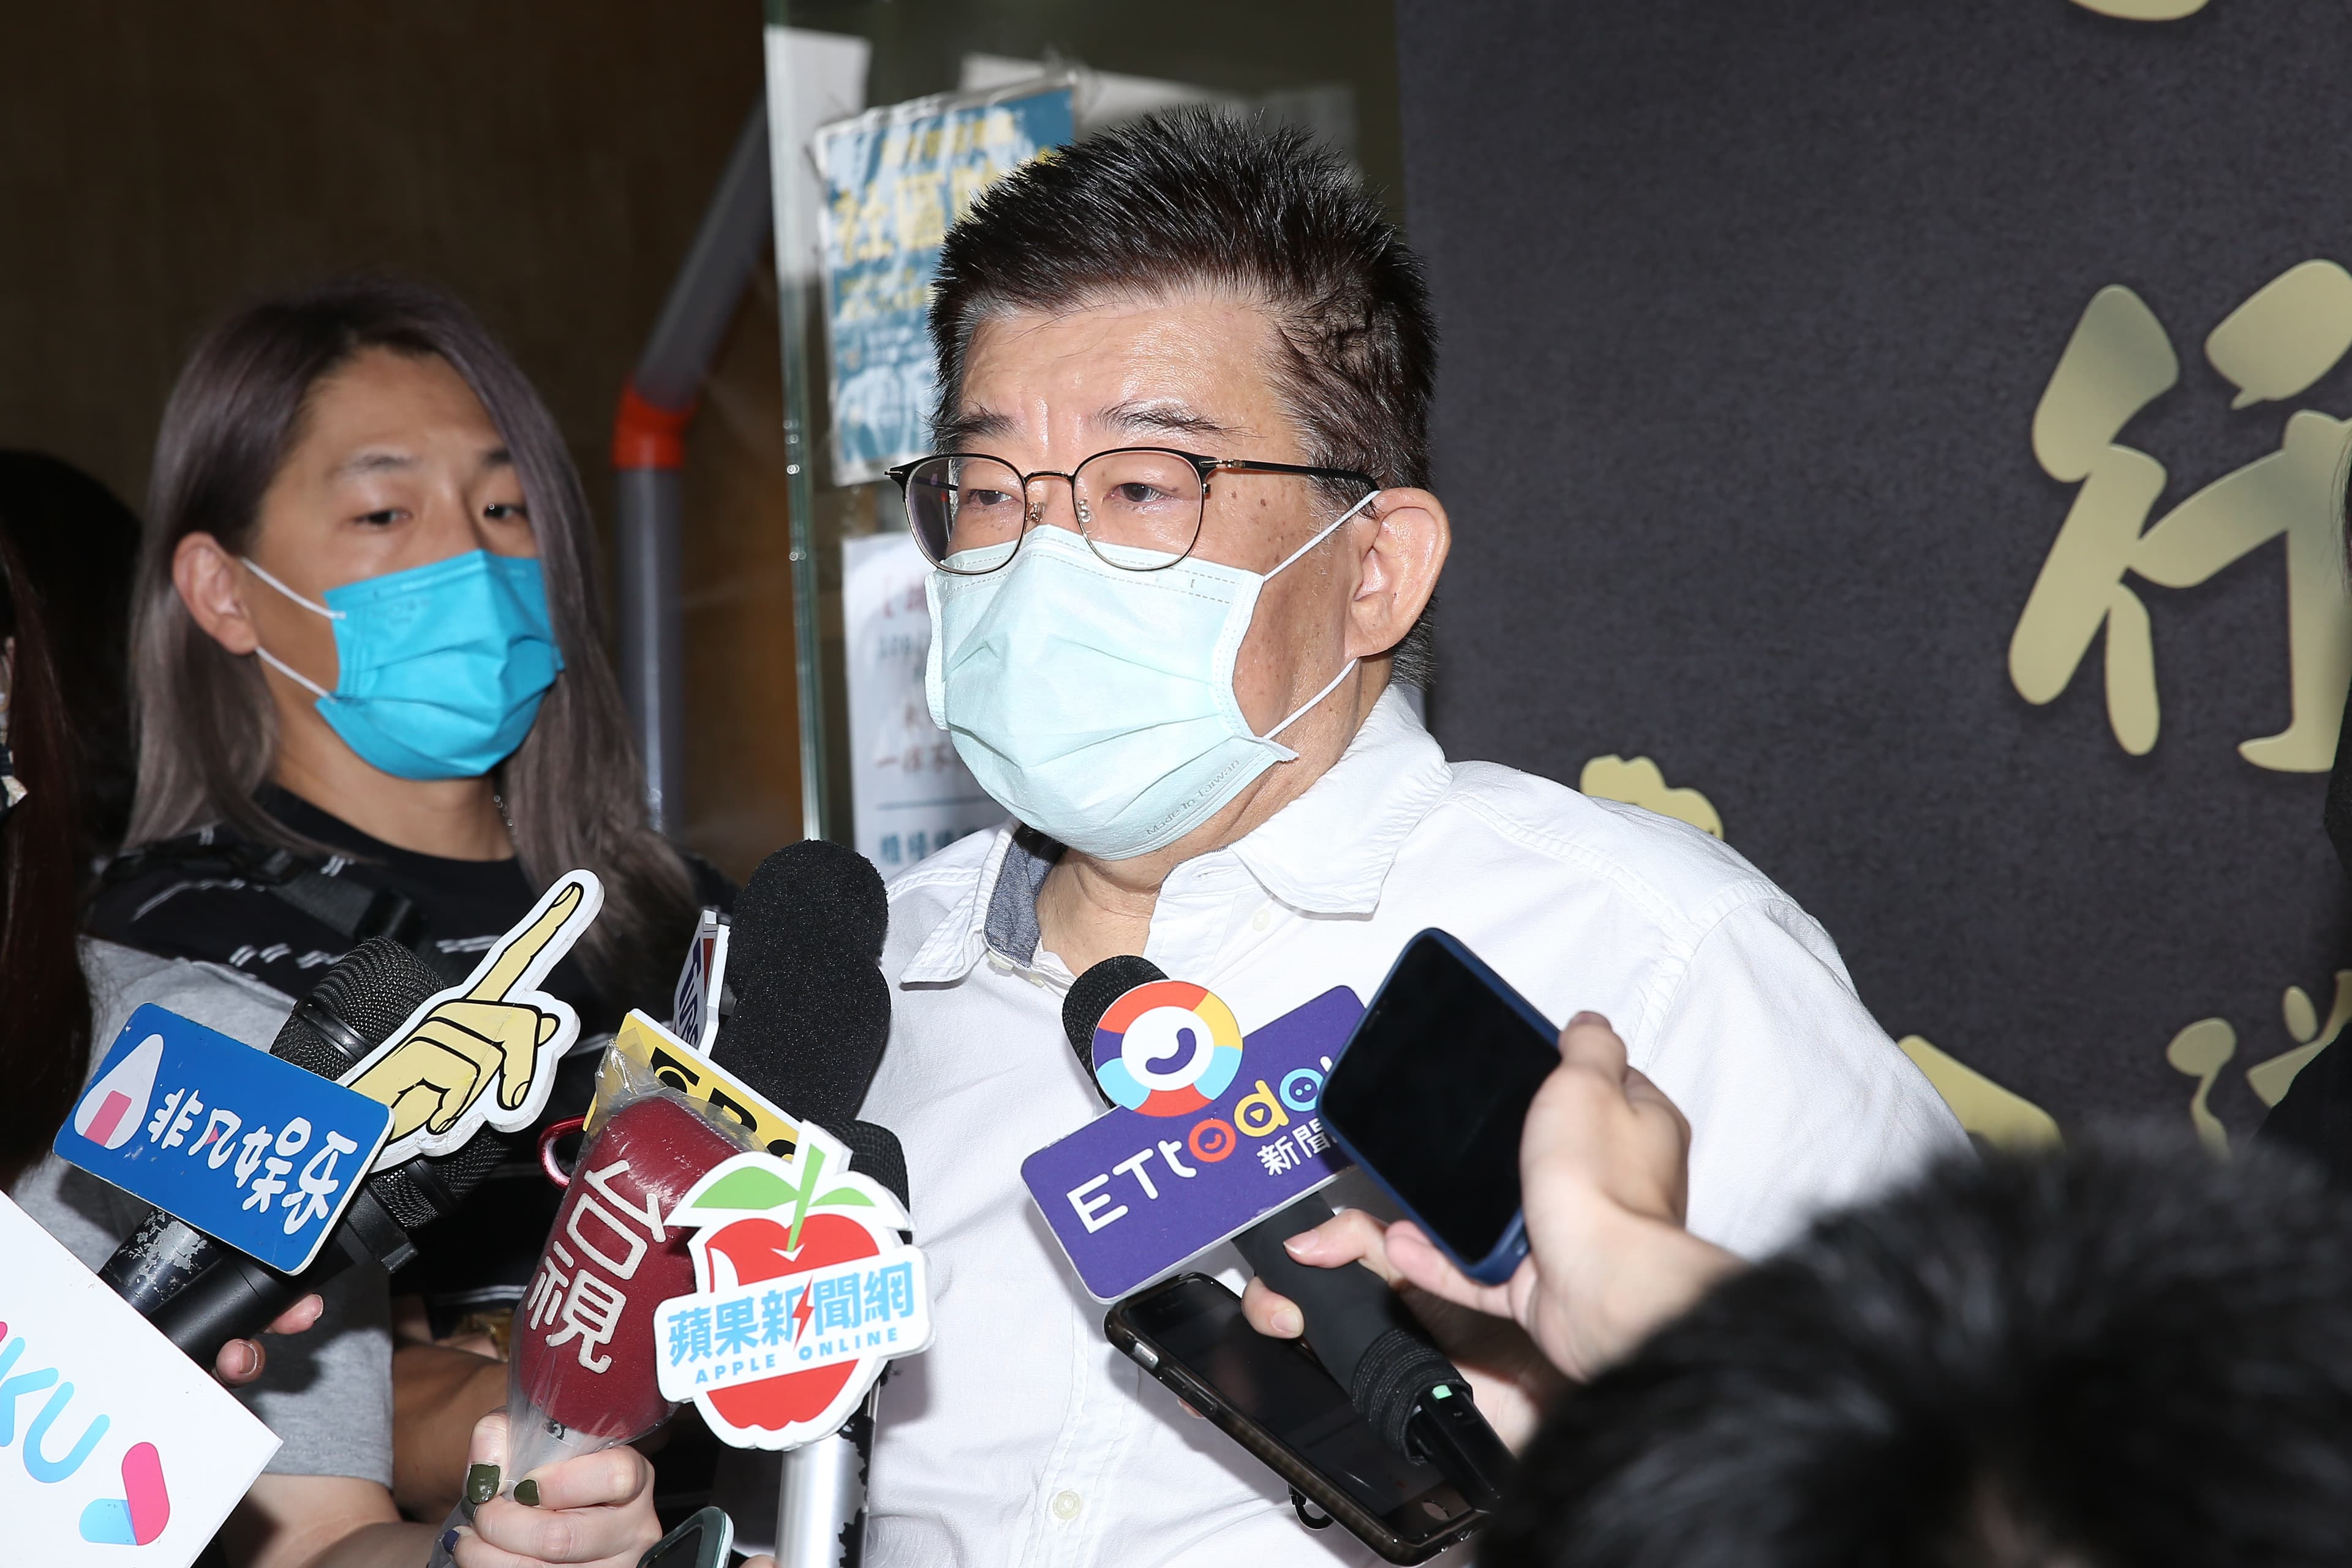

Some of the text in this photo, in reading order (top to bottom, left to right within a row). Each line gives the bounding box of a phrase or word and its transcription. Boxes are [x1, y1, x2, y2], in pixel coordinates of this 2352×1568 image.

[1146, 810, 1180, 835] Made
[1197, 760, 1240, 797] Taiwan
[1066, 1055, 1333, 1234] ETtoda
[1256, 1117, 1338, 1176] 新聞
[527, 1159, 666, 1374] 台視
[667, 1261, 914, 1368] 蘋果新聞網
[0, 1322, 111, 1483] KU
[695, 1327, 898, 1384] APPLE ONLINE
